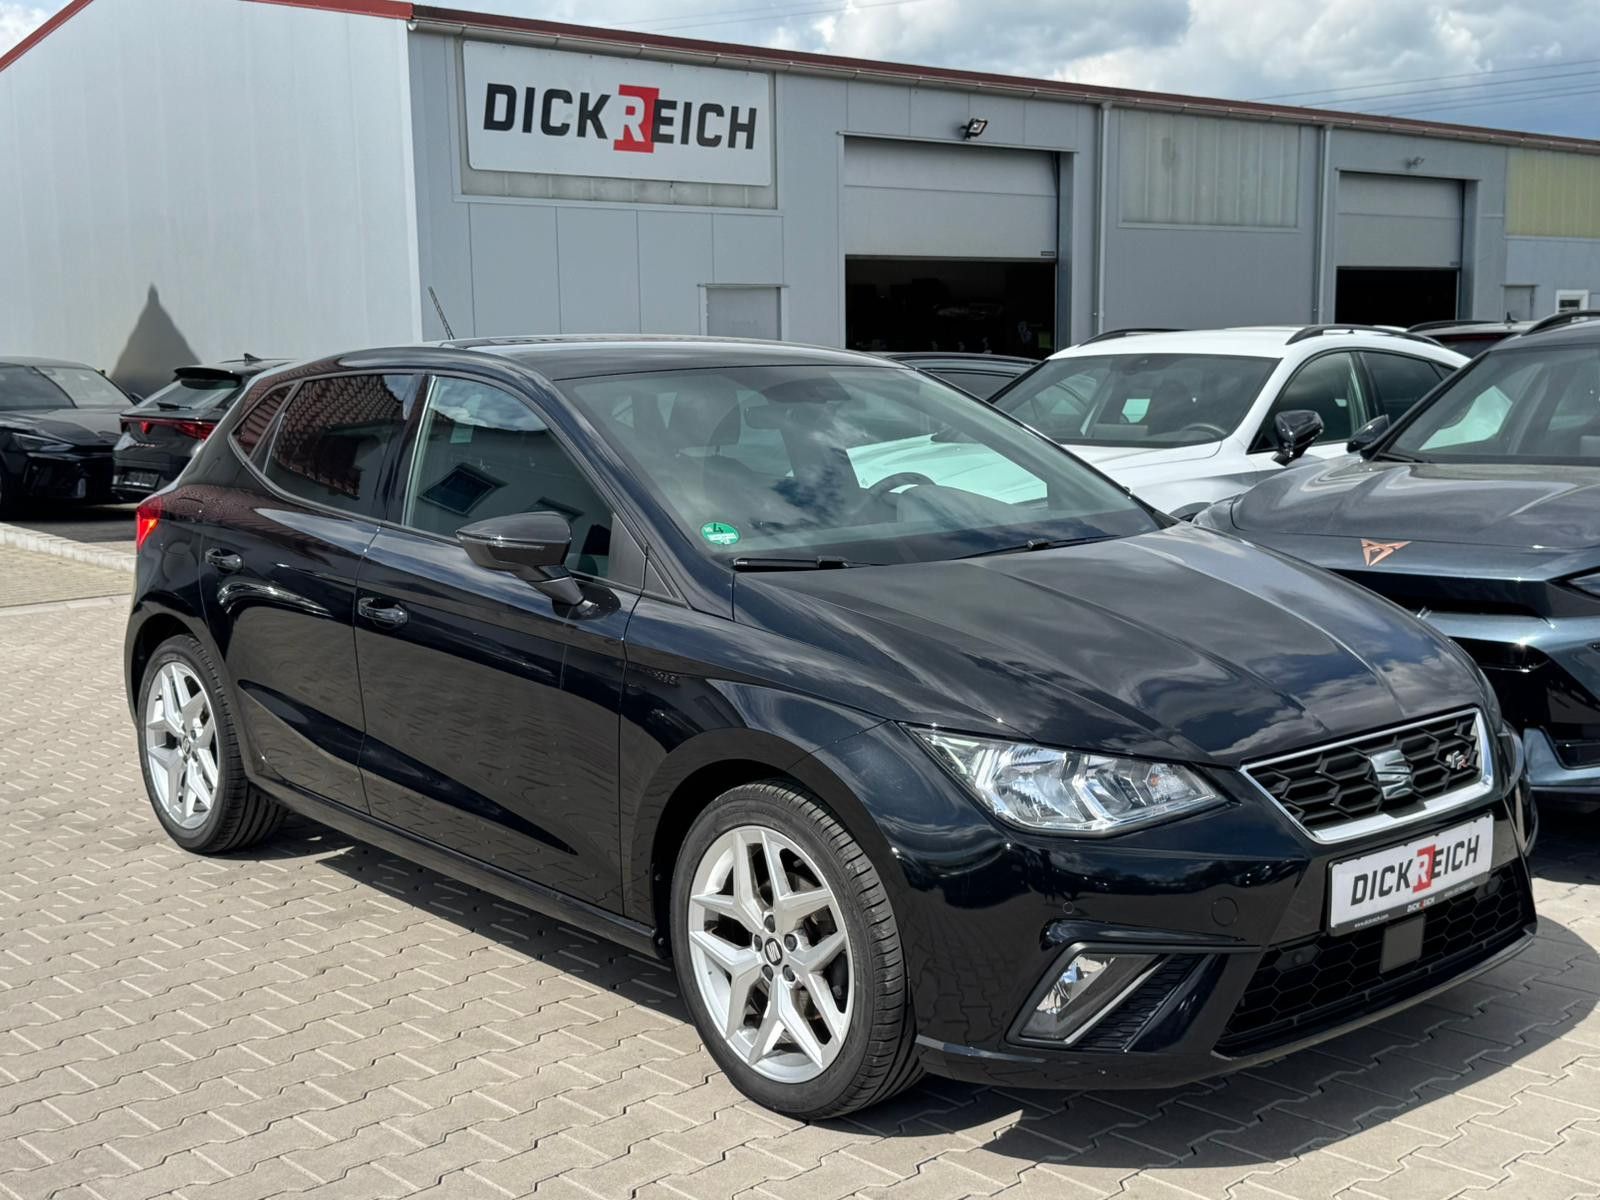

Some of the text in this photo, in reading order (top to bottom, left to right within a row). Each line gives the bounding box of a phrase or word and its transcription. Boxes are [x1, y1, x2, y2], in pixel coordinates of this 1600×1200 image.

[483, 83, 757, 153] DICKREICH
[713, 523, 724, 533] 4
[1350, 835, 1480, 906] DICKREICH
